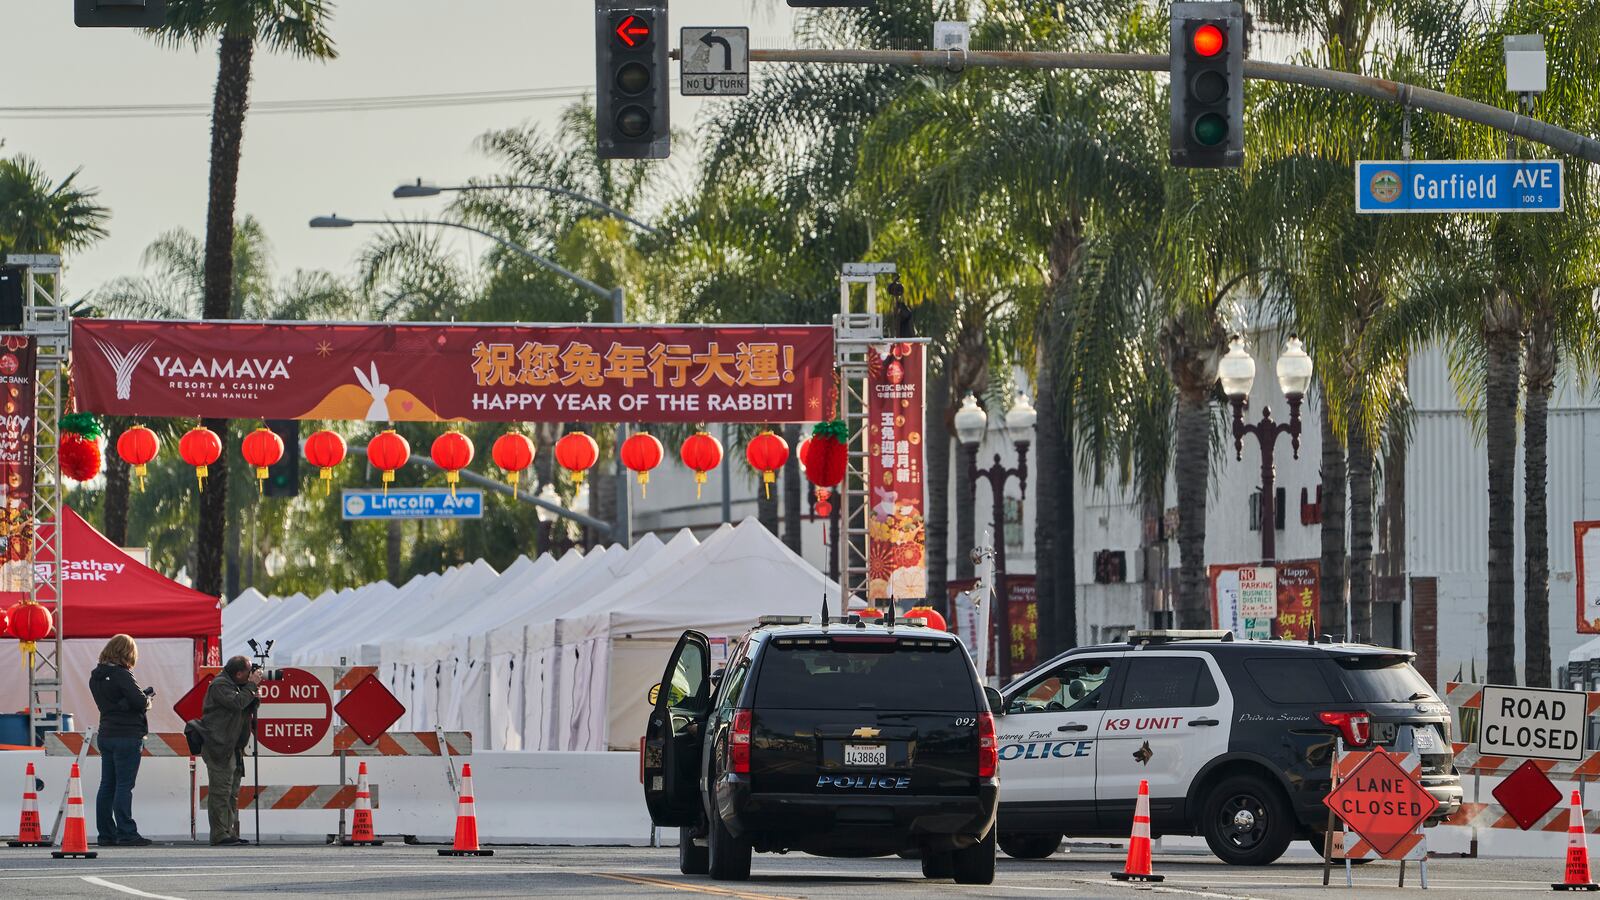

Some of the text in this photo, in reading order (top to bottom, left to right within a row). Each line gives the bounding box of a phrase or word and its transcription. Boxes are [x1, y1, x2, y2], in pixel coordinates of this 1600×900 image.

[686, 78, 744, 90] NO U TURN
[1413, 169, 1552, 200] Garfield AVE
[1522, 195, 1535, 203] 100
[153, 355, 293, 379] YAAMAVA'
[471, 341, 795, 388] 祝您兔年行大運!
[9, 376, 29, 384] BANK
[169, 381, 213, 389] RESORT
[232, 383, 275, 391] CASINO
[472, 393, 793, 411] HAPPY YEAR OF THE RABBIT!
[0, 414, 30, 436] appy
[371, 494, 475, 509] Lincoln Ave
[60, 560, 125, 574] Cathay
[1284, 569, 1310, 577] Happy
[1240, 569, 1255, 580] NO
[1241, 582, 1273, 590] PARKING
[260, 685, 320, 698] DO NOT
[1501, 697, 1566, 721] ROAD
[955, 717, 976, 727] 092
[1105, 717, 1184, 731] K9 UNIT
[1238, 713, 1264, 722] Pride
[1277, 713, 1310, 721] Service
[265, 723, 313, 737] ENTER
[997, 730, 1052, 743] nterey Park
[1485, 724, 1578, 751] CLOSED
[997, 740, 1093, 760] OLICE
[846, 752, 885, 763] 1438868
[816, 775, 911, 789] POLICE
[1356, 778, 1405, 793] LANE
[1342, 799, 1421, 816] CLOSED
